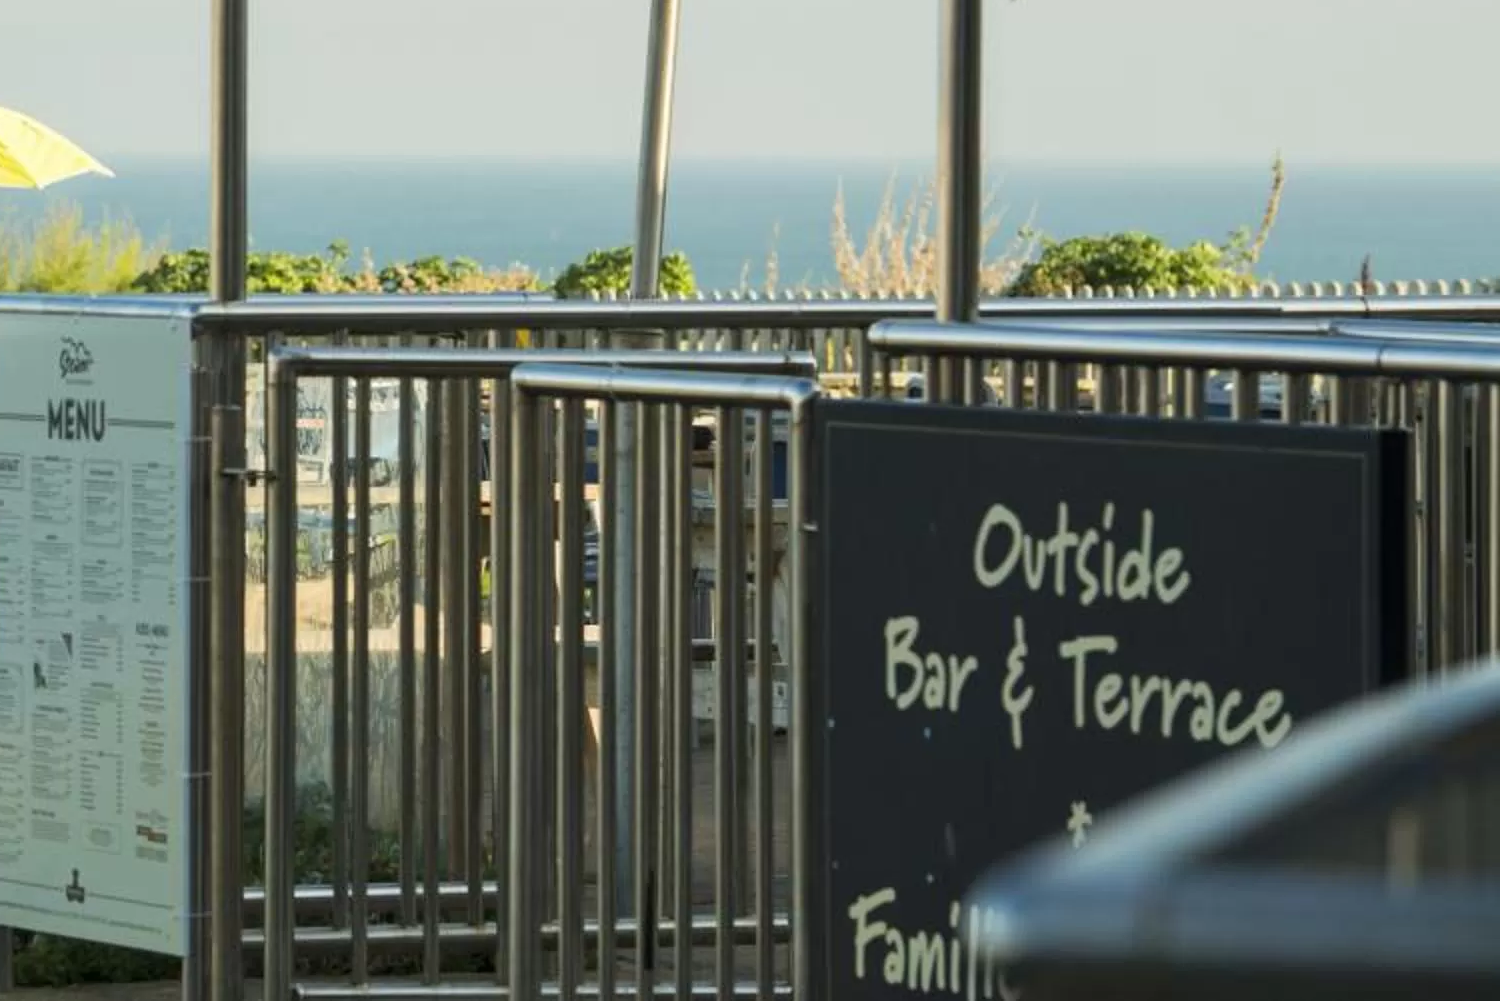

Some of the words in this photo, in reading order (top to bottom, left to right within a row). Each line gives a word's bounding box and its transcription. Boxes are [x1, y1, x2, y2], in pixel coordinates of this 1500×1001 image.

[47, 398, 106, 442] MENU
[973, 501, 1192, 606] Outside
[884, 614, 979, 711] Bar
[1001, 615, 1034, 750] &
[1058, 634, 1293, 749] Terrace
